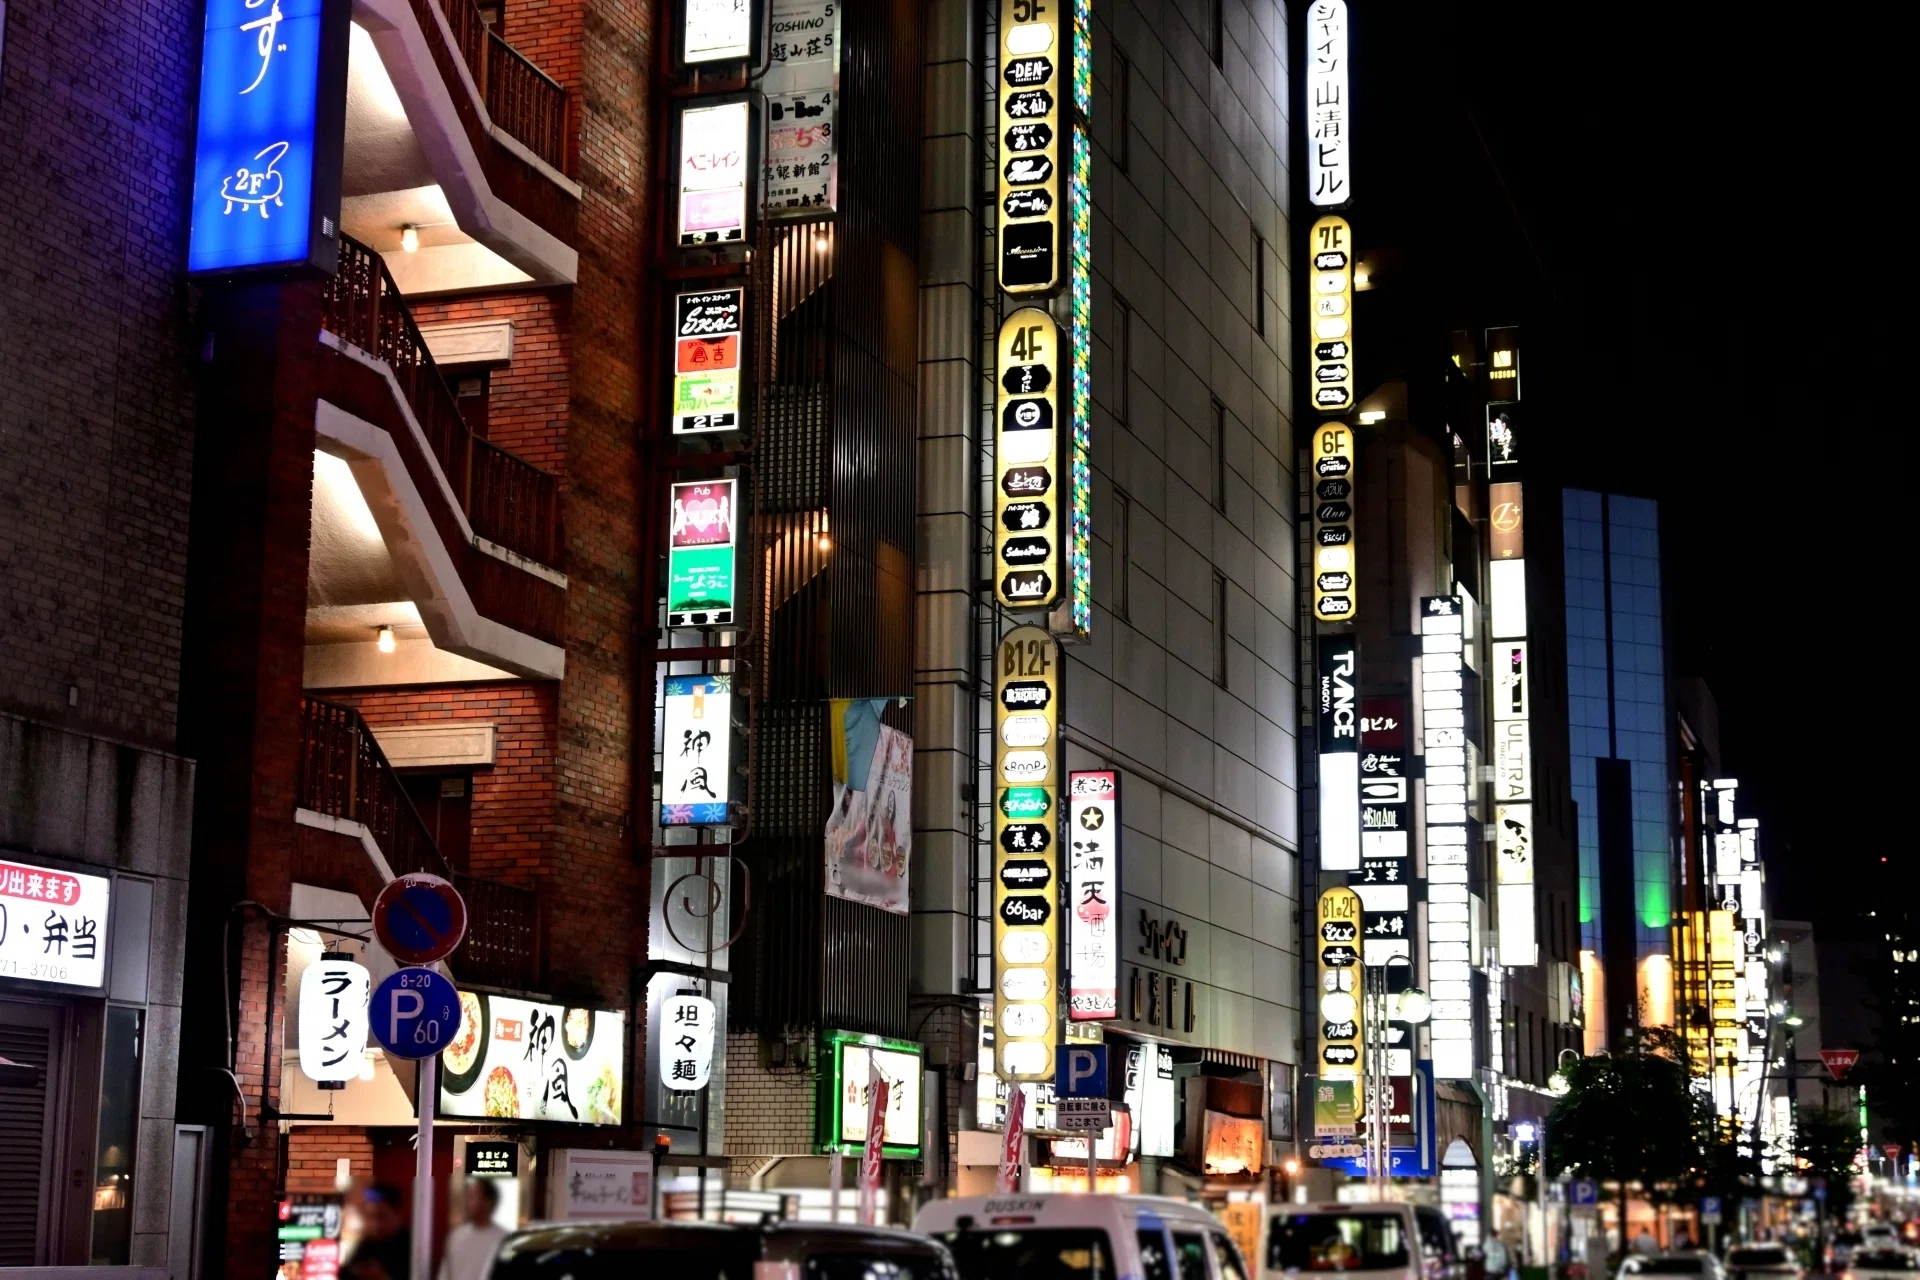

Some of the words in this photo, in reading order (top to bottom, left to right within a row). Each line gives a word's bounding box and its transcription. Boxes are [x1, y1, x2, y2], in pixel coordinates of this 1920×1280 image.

[825, 4, 834, 17] 5
[824, 34, 833, 46] 5
[822, 93, 832, 105] 4
[1011, 98, 1047, 116] 水仙
[1315, 5, 1343, 197] シャイン山清ビル
[821, 153, 830, 166] 2
[235, 168, 264, 194] 2F
[1319, 225, 1343, 249] 7F
[1010, 325, 1043, 361] 4F
[694, 414, 724, 428] 2F
[1322, 430, 1345, 454] 6F
[694, 487, 711, 496] Pub
[1322, 676, 1330, 714] NAGOYA
[1333, 650, 1354, 738] TRANCE
[1507, 723, 1524, 798] ULTRA
[1073, 777, 1113, 795] 煮こみ
[1006, 901, 1044, 921] 66bar
[400, 975, 431, 987] 8-20
[321, 971, 352, 1067] ラーメン
[390, 989, 424, 1044] P
[414, 1019, 439, 1044] 60
[1068, 1050, 1097, 1092] P
[1058, 1102, 1107, 1112] 自転車に限る
[1066, 1117, 1100, 1127] ここまで
